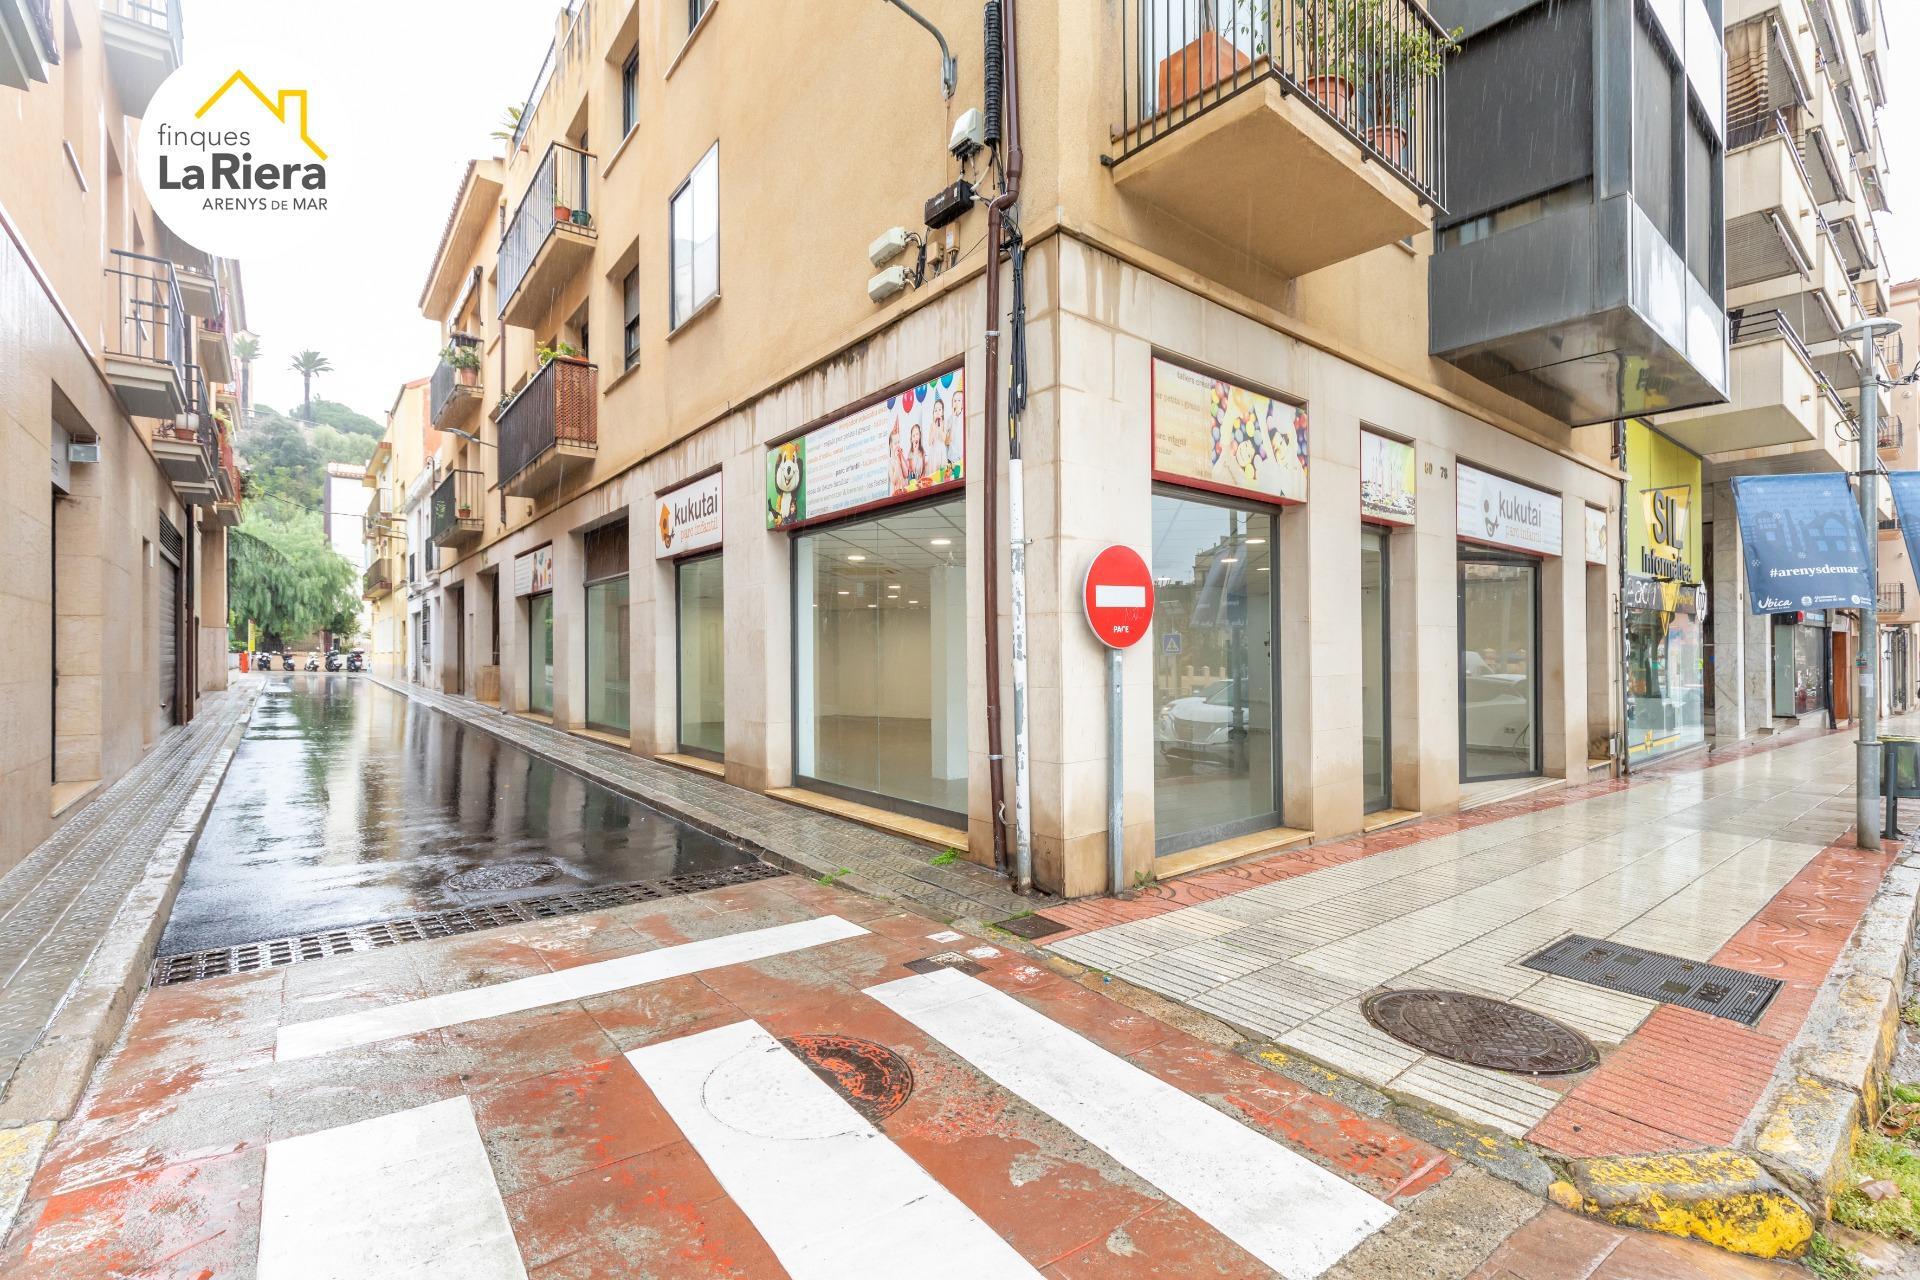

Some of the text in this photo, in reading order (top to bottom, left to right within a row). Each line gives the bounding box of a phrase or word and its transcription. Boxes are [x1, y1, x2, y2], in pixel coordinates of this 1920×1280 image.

[674, 486, 718, 527] kukutai
[1499, 490, 1542, 528] kukutai
[1652, 490, 1684, 549] SIL
[1769, 564, 1859, 578] #arenysdemar
